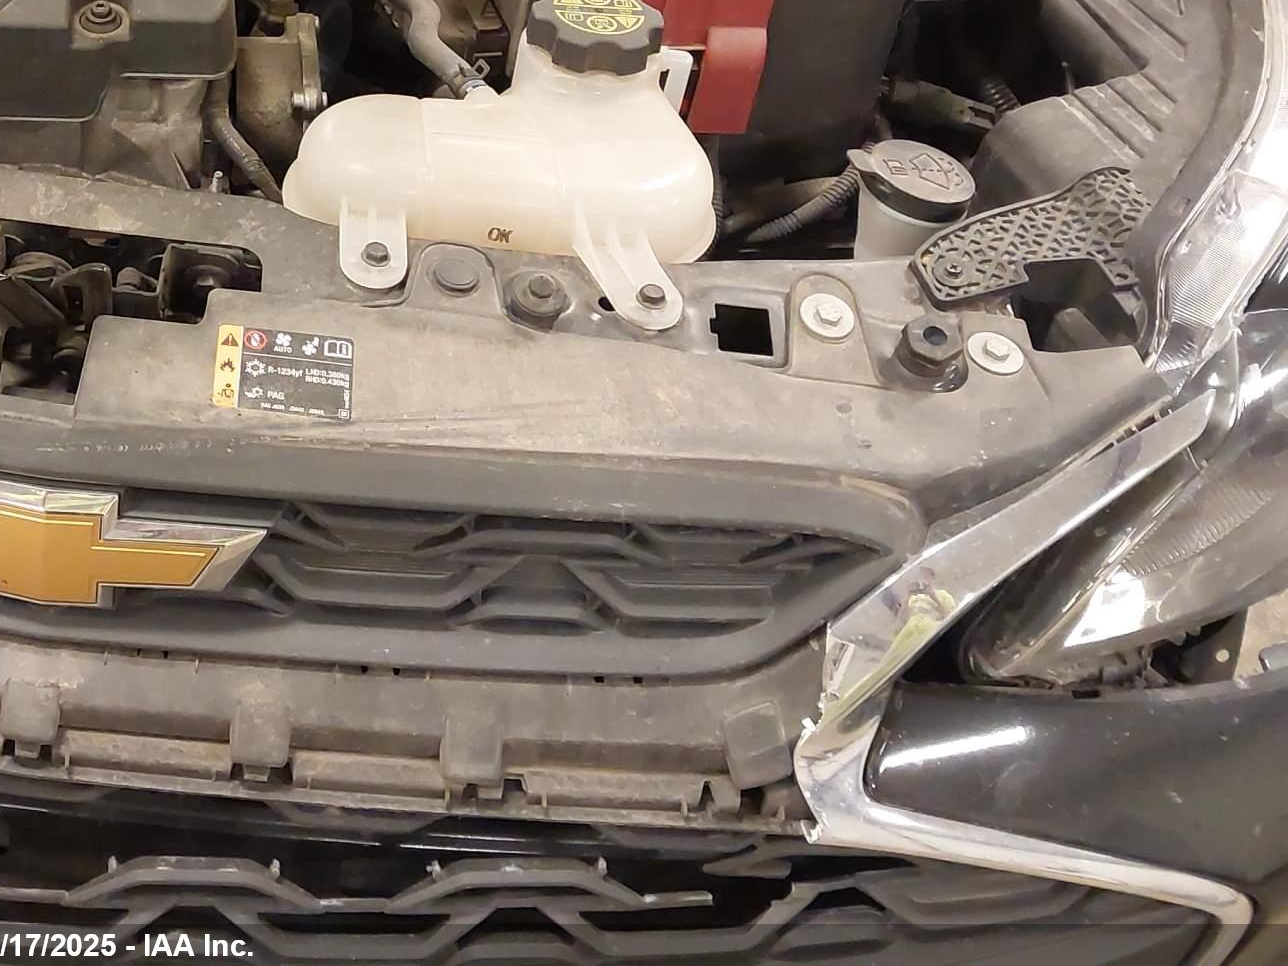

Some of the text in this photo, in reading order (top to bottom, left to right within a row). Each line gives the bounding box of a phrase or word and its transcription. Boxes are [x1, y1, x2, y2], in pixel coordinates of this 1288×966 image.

[487, 227, 513, 243] OK
[273, 345, 293, 353] AUTO
[267, 365, 303, 378] R-1234yf
[267, 390, 286, 400] PAG
